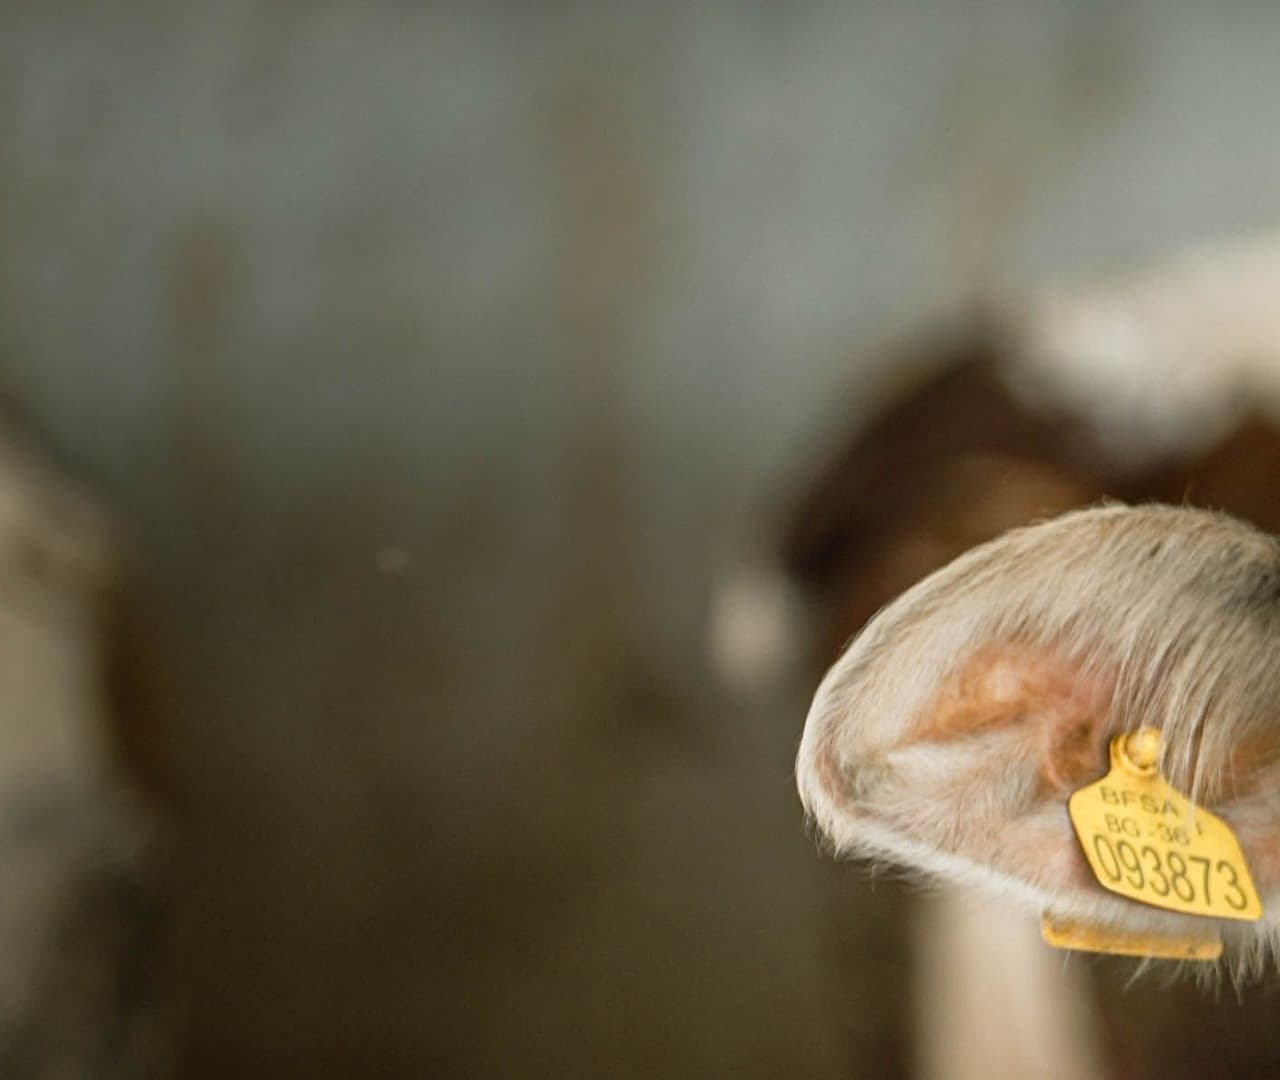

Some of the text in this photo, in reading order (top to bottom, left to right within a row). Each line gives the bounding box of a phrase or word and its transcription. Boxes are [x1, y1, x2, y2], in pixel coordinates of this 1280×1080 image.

[1100, 786, 1179, 816] BFSA
[1104, 813, 1140, 837] BG
[1093, 833, 1248, 910] 093873
